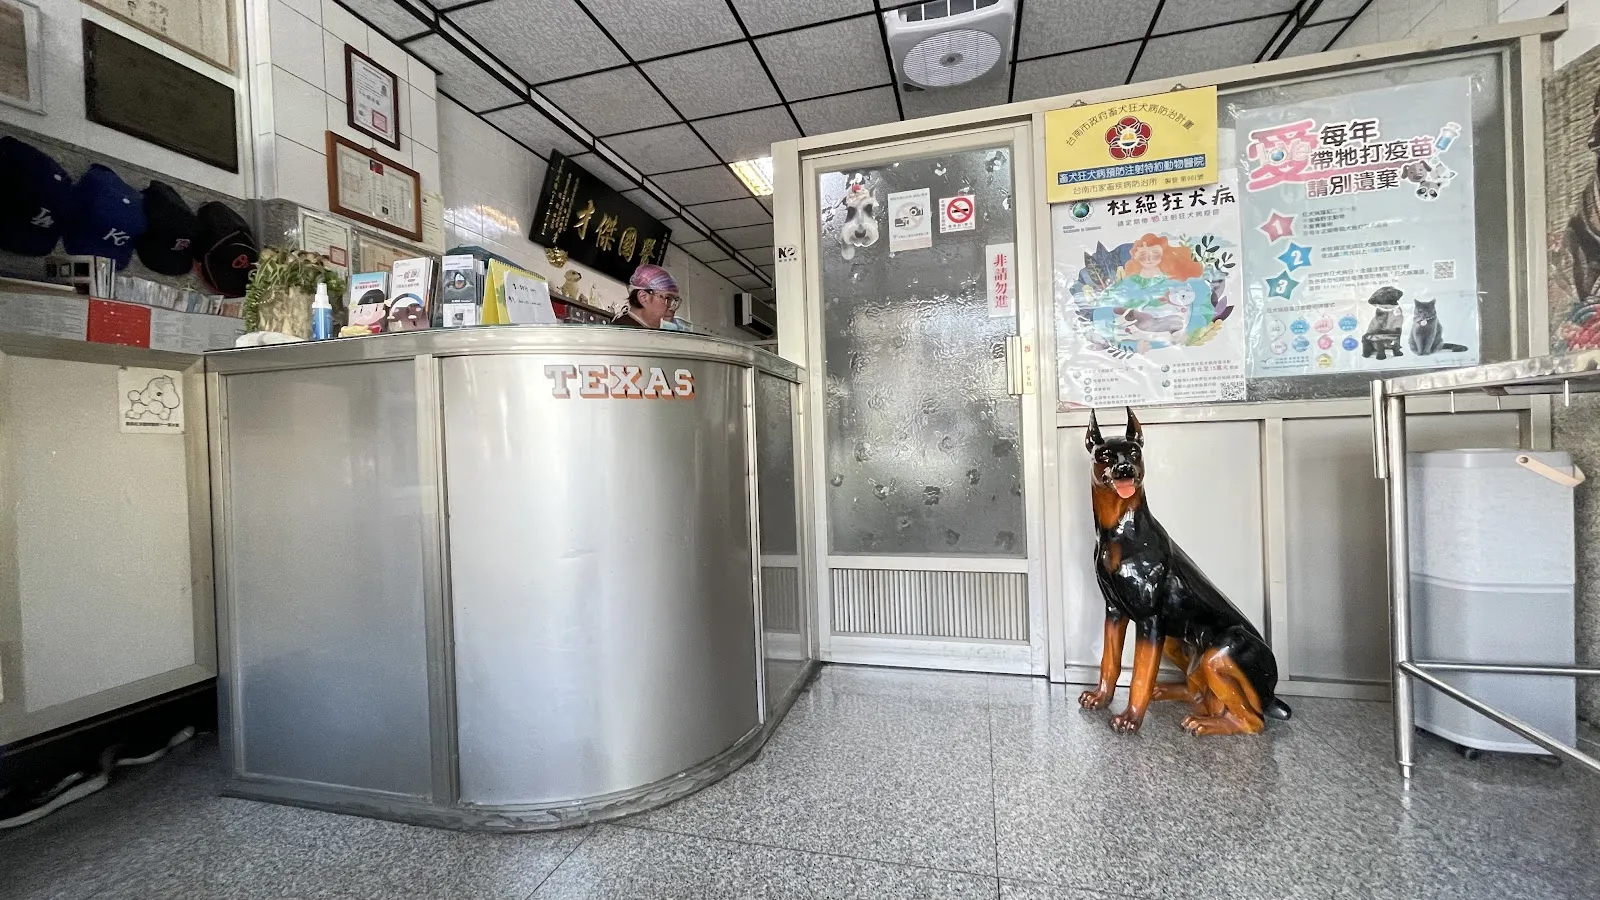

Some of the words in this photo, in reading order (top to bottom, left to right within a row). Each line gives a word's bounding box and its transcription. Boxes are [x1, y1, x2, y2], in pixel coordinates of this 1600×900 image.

[1320, 120, 1377, 147] 每年
[1249, 120, 1319, 191] 愛
[1310, 136, 1435, 170] 帶牠打疫苗
[1307, 169, 1400, 198] 請別遺棄
[1107, 184, 1236, 216] 杜絕狂犬病
[102, 227, 130, 246] KC
[1271, 219, 1283, 235] 1
[1291, 250, 1304, 266] 2
[993, 253, 1008, 308] 非請勿進
[1276, 279, 1289, 294] 3
[544, 364, 696, 400] TEXAS
